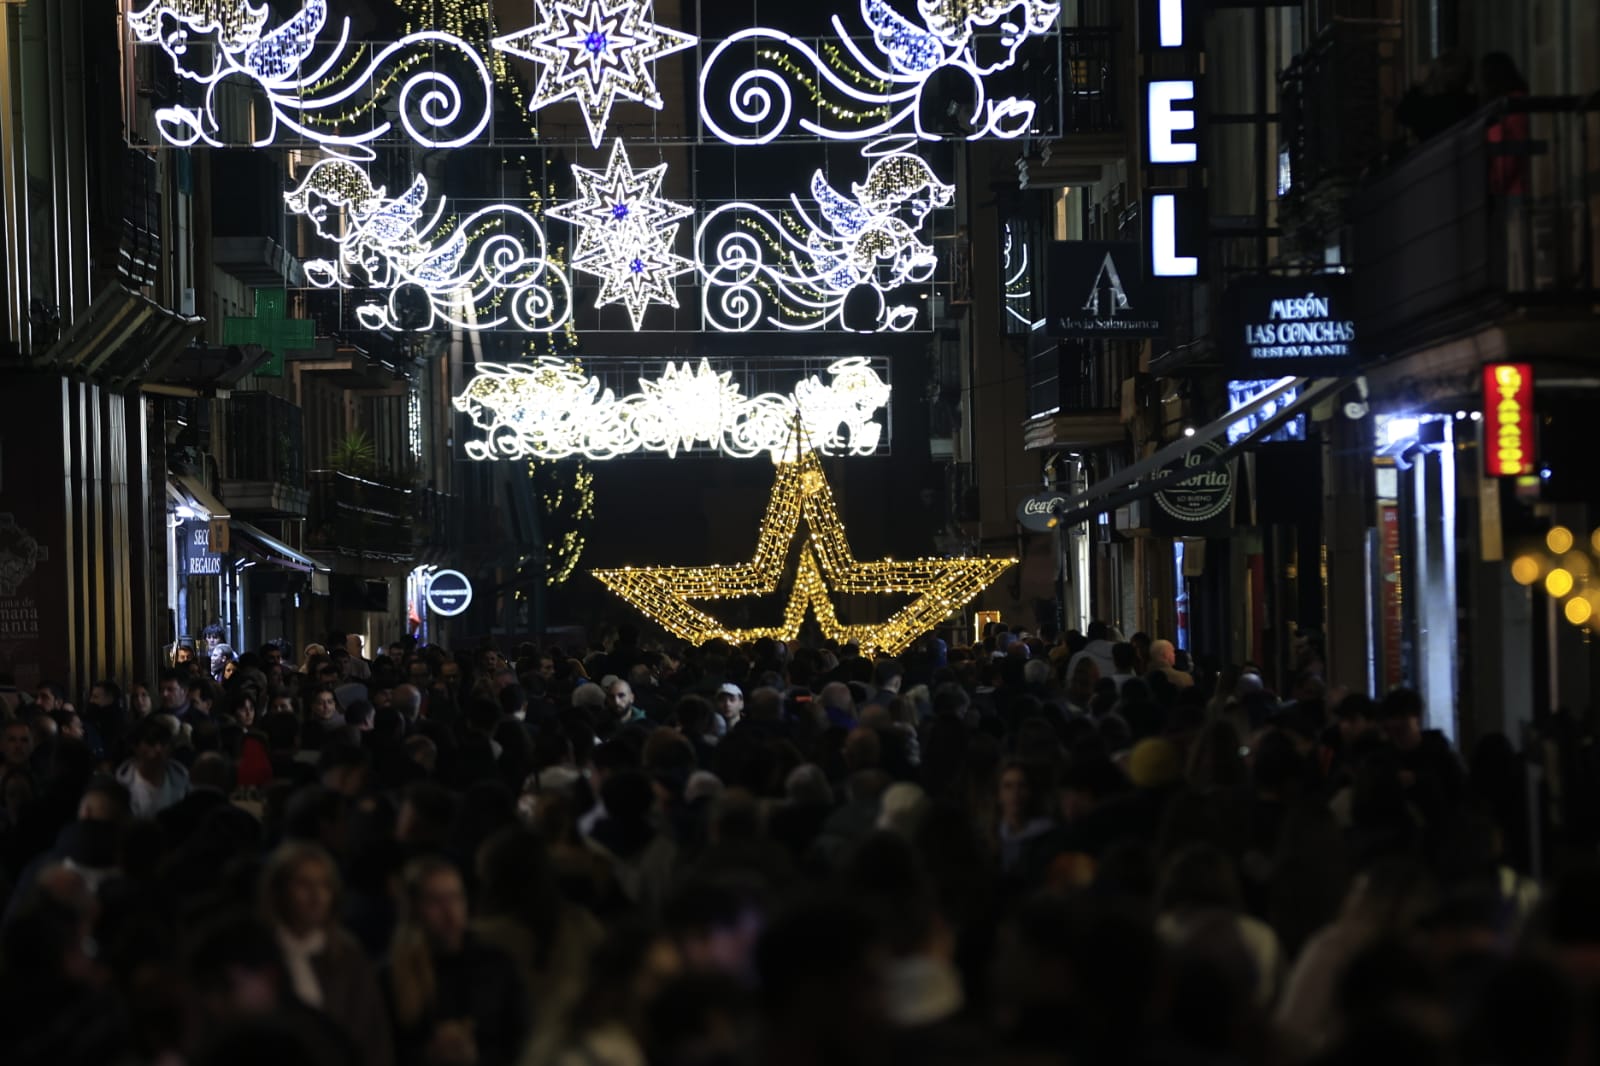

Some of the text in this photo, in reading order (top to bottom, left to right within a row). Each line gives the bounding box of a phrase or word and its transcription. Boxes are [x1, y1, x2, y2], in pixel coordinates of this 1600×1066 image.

[1269, 292, 1328, 320] MESÓN
[1245, 321, 1355, 344] LAS CONCHAS
[190, 557, 221, 574] REGALOS
